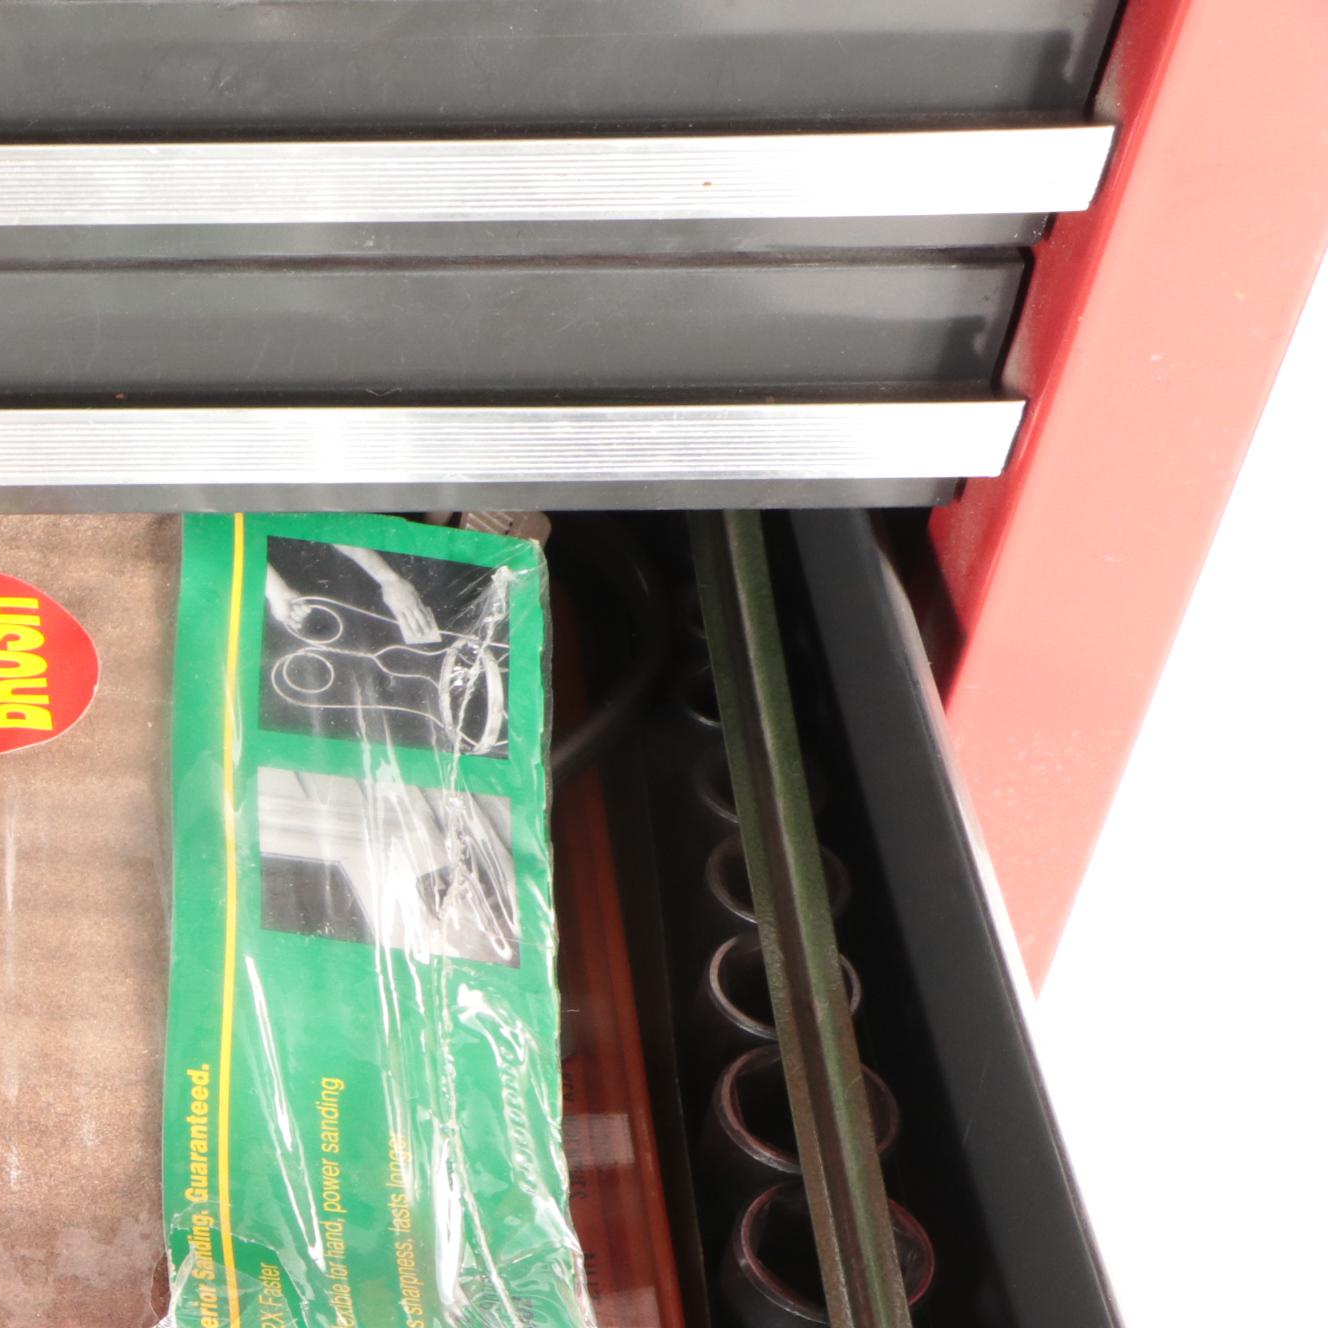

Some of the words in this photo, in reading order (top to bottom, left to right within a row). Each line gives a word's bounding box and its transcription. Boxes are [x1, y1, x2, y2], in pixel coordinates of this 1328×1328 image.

[184, 1063, 210, 1202] Guaranteed.
[315, 1077, 345, 1153] sanding
[320, 1158, 348, 1213] power
[386, 1192, 412, 1232] lasts
[258, 1263, 283, 1307] Faster
